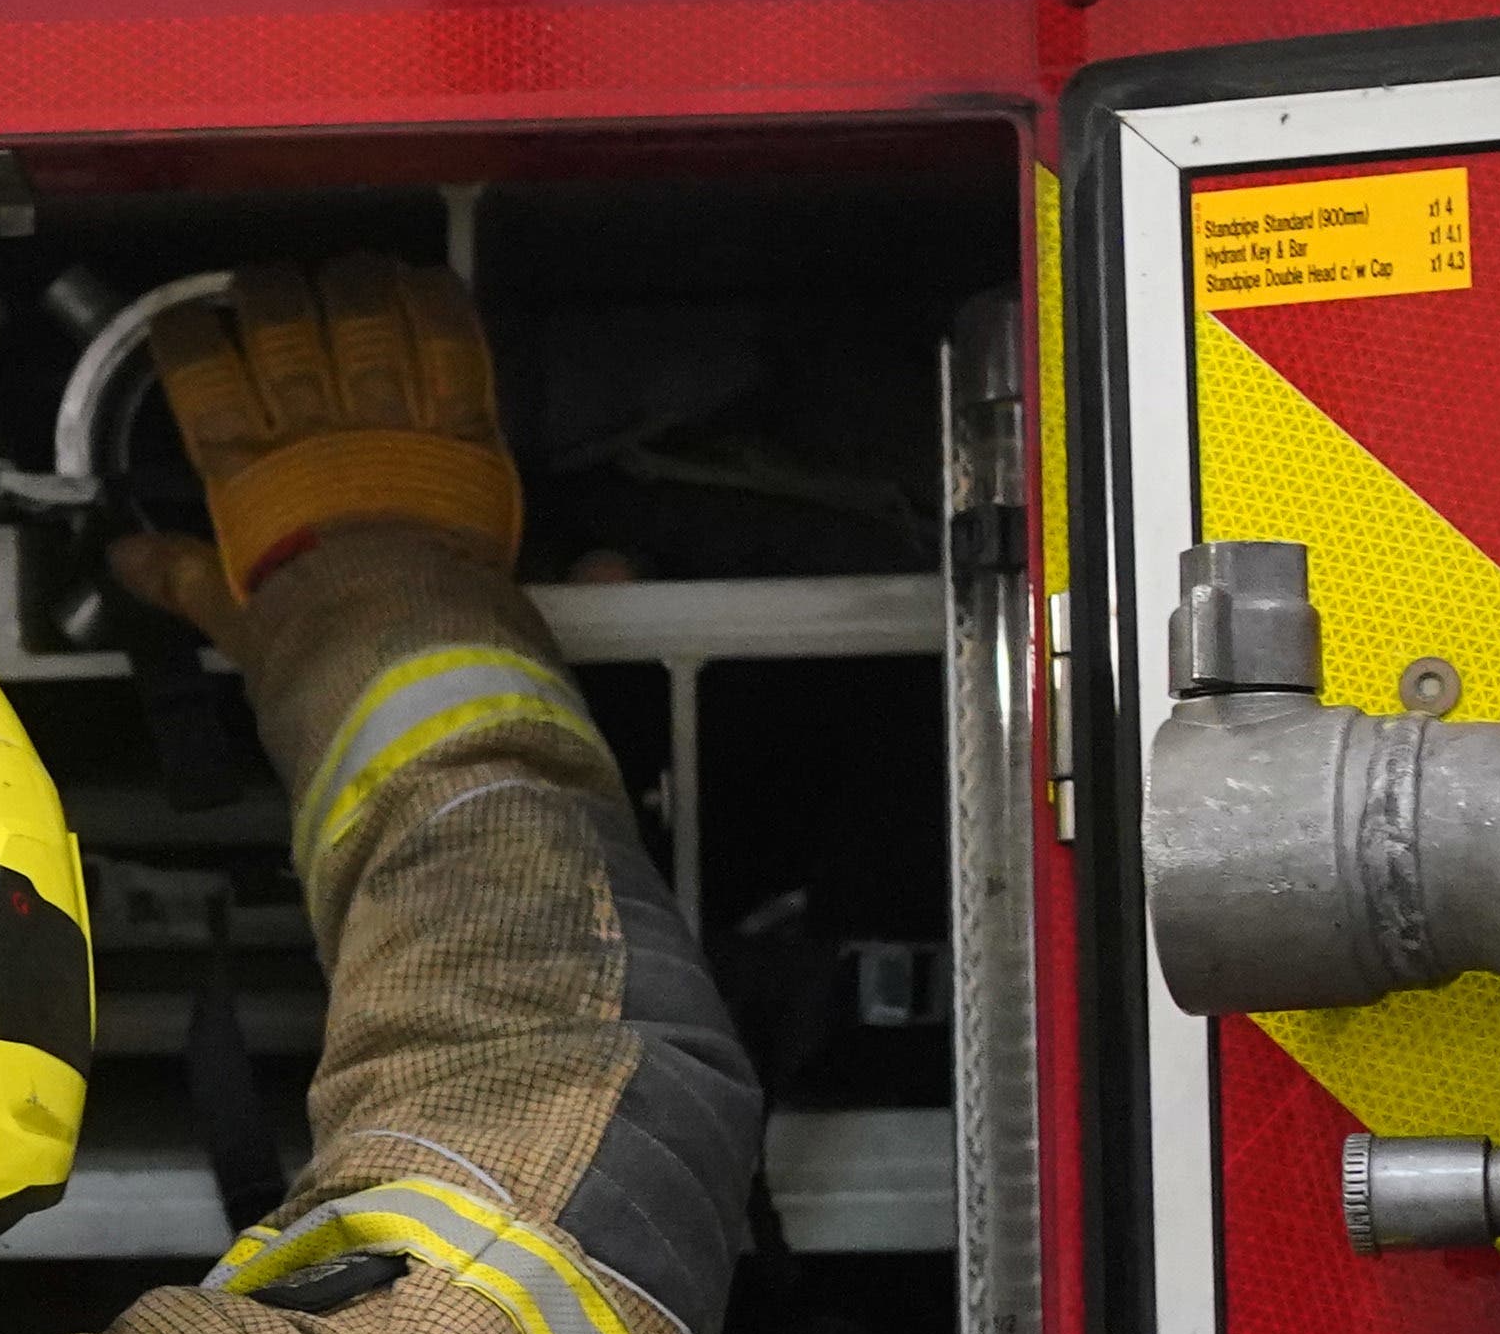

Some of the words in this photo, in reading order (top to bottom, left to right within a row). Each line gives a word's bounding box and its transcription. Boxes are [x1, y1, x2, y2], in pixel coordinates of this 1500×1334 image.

[1205, 217, 1260, 240] Standpipe
[1263, 210, 1315, 232] Standard
[1318, 203, 1370, 229] (900mm)
[1444, 196, 1454, 215] 4
[1204, 244, 1247, 266] Hydrant
[1250, 242, 1272, 265] Key
[1275, 240, 1285, 259] &
[1288, 239, 1309, 259] Bar
[1206, 271, 1262, 294] Standpipe
[1265, 264, 1304, 287] Double
[1307, 262, 1337, 284] Head
[1370, 258, 1394, 281] Cap
